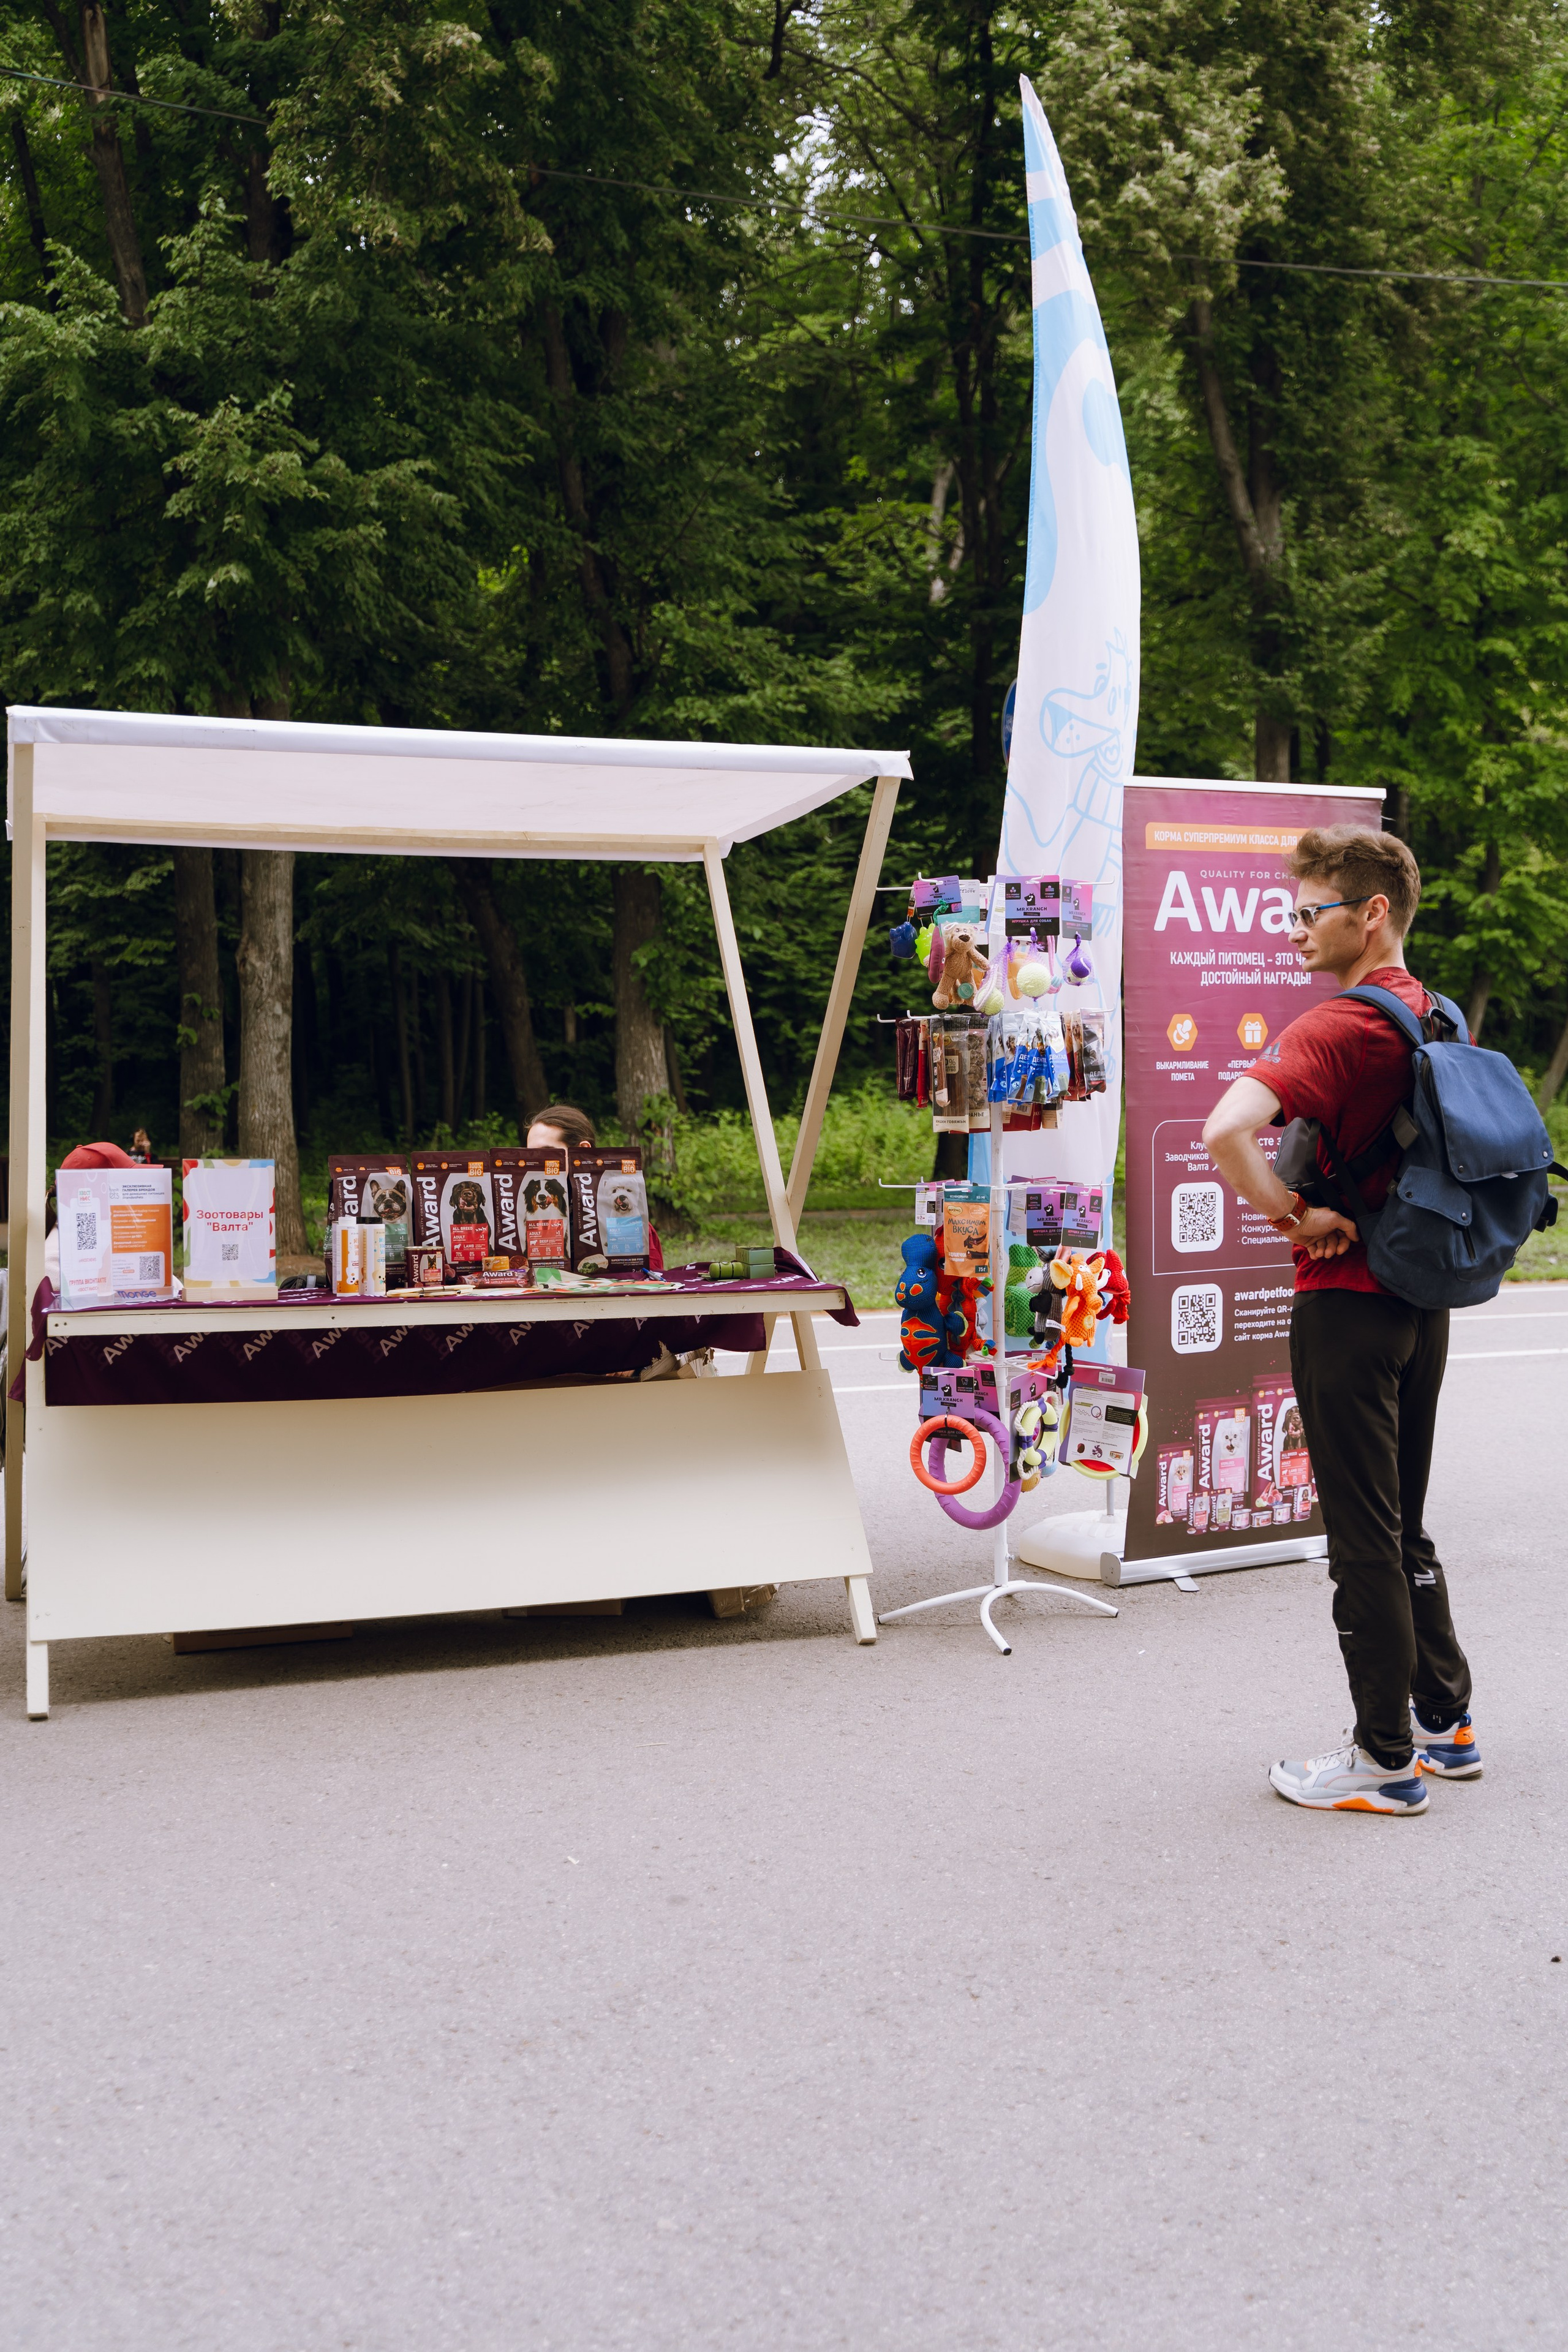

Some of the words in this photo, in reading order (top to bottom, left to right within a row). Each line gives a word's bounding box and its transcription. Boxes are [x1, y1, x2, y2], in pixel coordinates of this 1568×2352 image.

[1154, 831, 1182, 842] КОРМА
[1183, 831, 1247, 845] СУПЕРПРЕМИУМ
[1249, 834, 1280, 846] КЛАССА
[1280, 835, 1297, 847] ДЛЯ
[1200, 870, 1245, 879] QUALITY
[1170, 949, 1216, 967] КАЖДЫЙ
[1218, 952, 1265, 967] ПИТОМЕЦ
[1275, 952, 1293, 965] ЭТО
[1200, 969, 1261, 986] ДОСТОЙНЫЙ
[1263, 971, 1311, 986] НАГРАДЫ!
[1156, 1061, 1209, 1070] ВЫКАРМЛИВАНИЕ
[1171, 1072, 1195, 1081] ПОМЕТА
[1164, 1153, 1209, 1163] Заводчиков
[1187, 1163, 1209, 1172] Валта
[337, 1175, 359, 1218] ard
[196, 1210, 263, 1221] Зоотовары
[494, 1174, 517, 1251] Award
[573, 1173, 597, 1247] Award
[207, 1221, 253, 1231] "Валта"
[952, 1226, 979, 1236] ВКУСА
[69, 1278, 84, 1286] ГРУППА
[1234, 1306, 1276, 1317] Сканируйте
[1234, 1320, 1275, 1330] переходите
[1234, 1333, 1251, 1341] сайт
[1252, 1332, 1273, 1341] корма
[1257, 1403, 1273, 1481] Award
[1198, 1423, 1211, 1489] Award
[1158, 1461, 1167, 1507] Award
